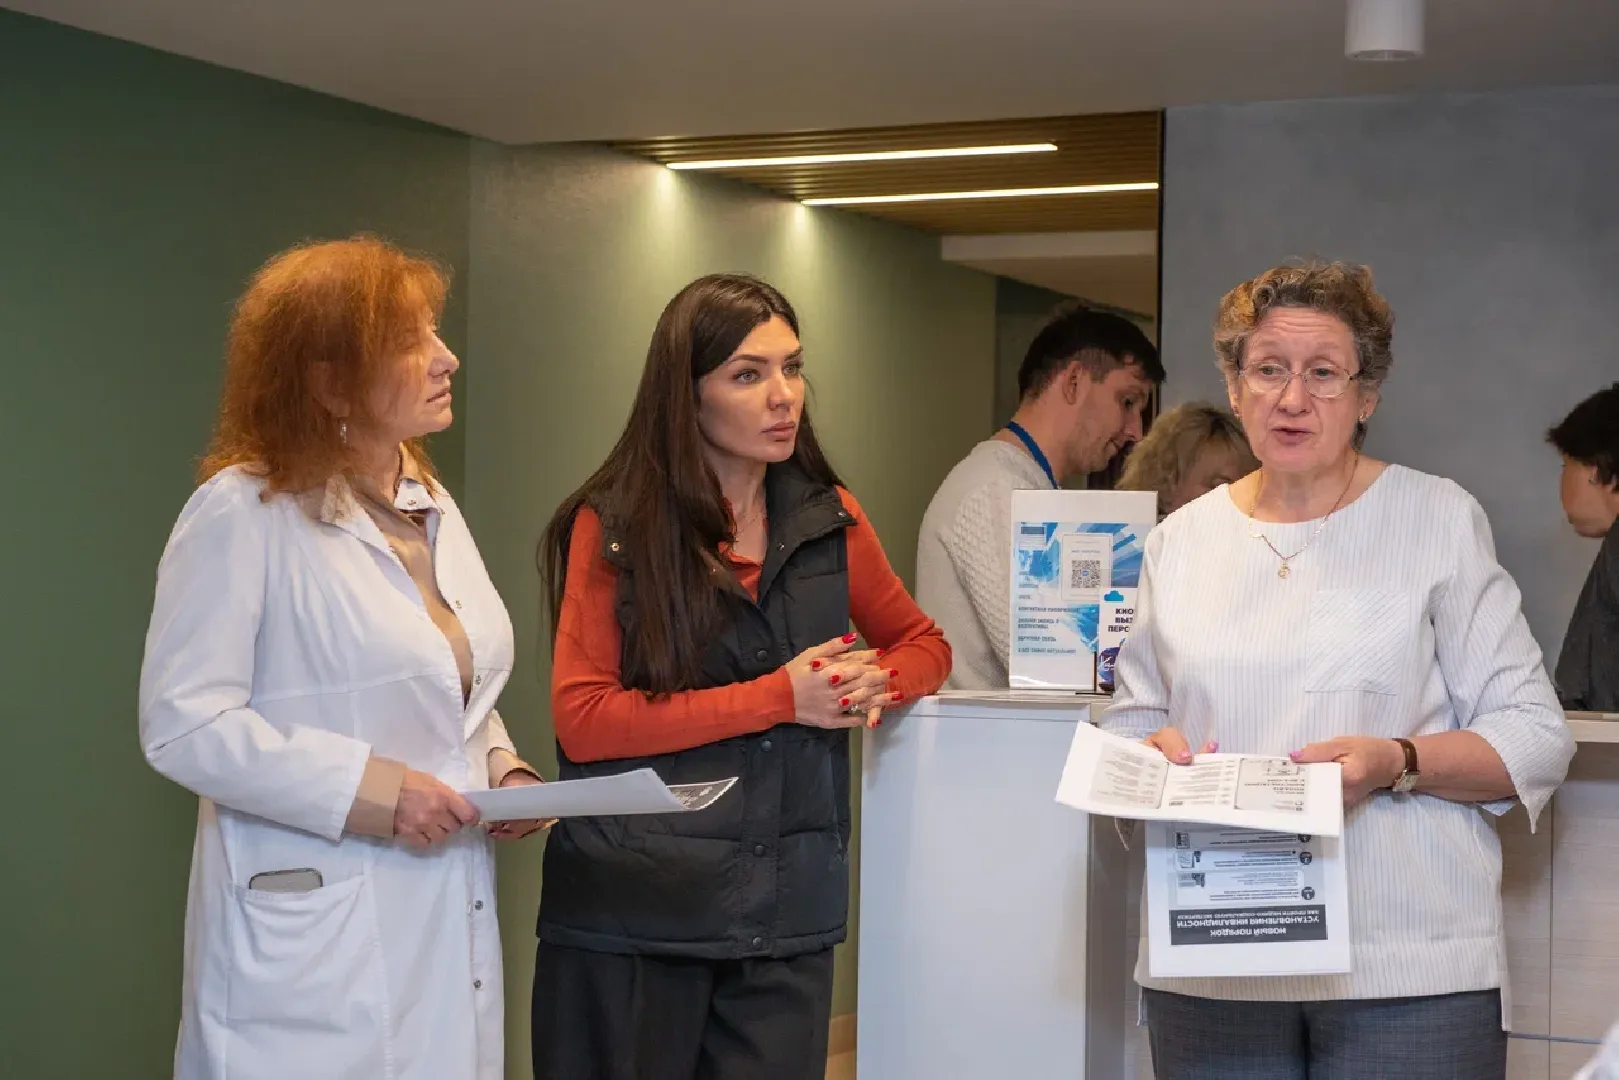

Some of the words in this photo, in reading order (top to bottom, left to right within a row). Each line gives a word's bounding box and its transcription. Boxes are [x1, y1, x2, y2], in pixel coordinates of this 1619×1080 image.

[1177, 919, 1248, 928] ИНВАЛИДНОСТИ
[1250, 916, 1319, 925] УСТАНОВЛЕНИЯ
[1210, 928, 1252, 937] ПОРЯДОК
[1254, 928, 1286, 936] НОВЫЙ
